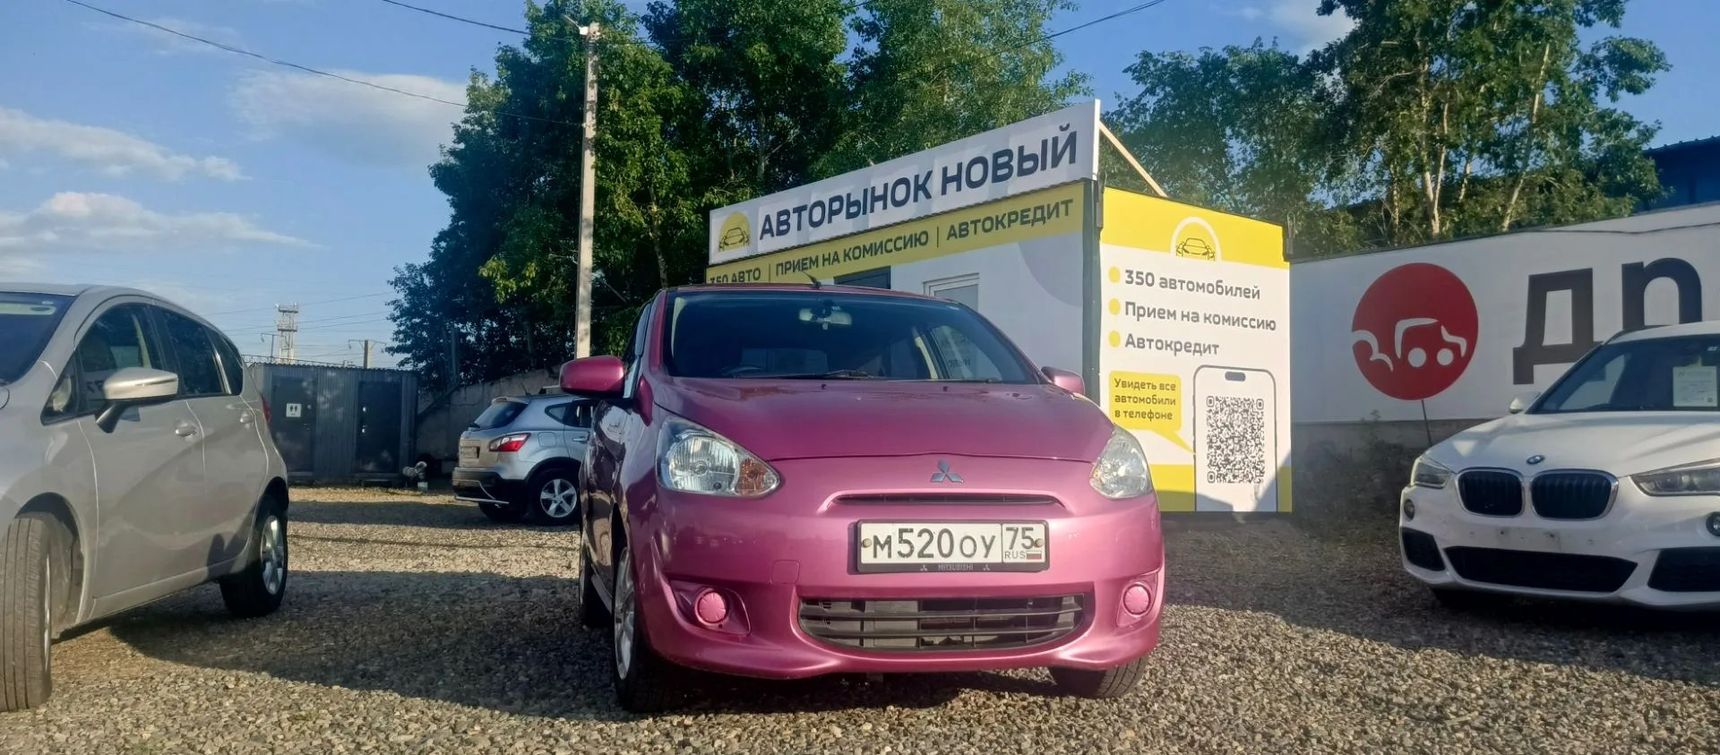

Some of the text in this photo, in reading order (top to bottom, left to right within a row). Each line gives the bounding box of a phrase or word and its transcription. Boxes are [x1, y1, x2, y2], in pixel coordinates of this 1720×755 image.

[759, 123, 1077, 240] АВТОРЫНОК НОВЫЙ
[731, 267, 761, 283] АВТО
[776, 255, 819, 276] ПРИЕМ
[822, 251, 840, 267] НА
[843, 230, 929, 262] КОМИССИЮ
[946, 199, 1073, 240] АВТОКРЕДИТ
[1125, 269, 1260, 299] 350 автомобилей
[1125, 301, 1276, 331] Прием на комиссию
[1125, 333, 1219, 357] Автокредит
[1114, 378, 1176, 392] Увидеть все
[1114, 394, 1176, 406] автомобили
[1123, 409, 1173, 421] телефоне
[1005, 527, 1034, 550] 75
[1004, 551, 1026, 560] RUS
